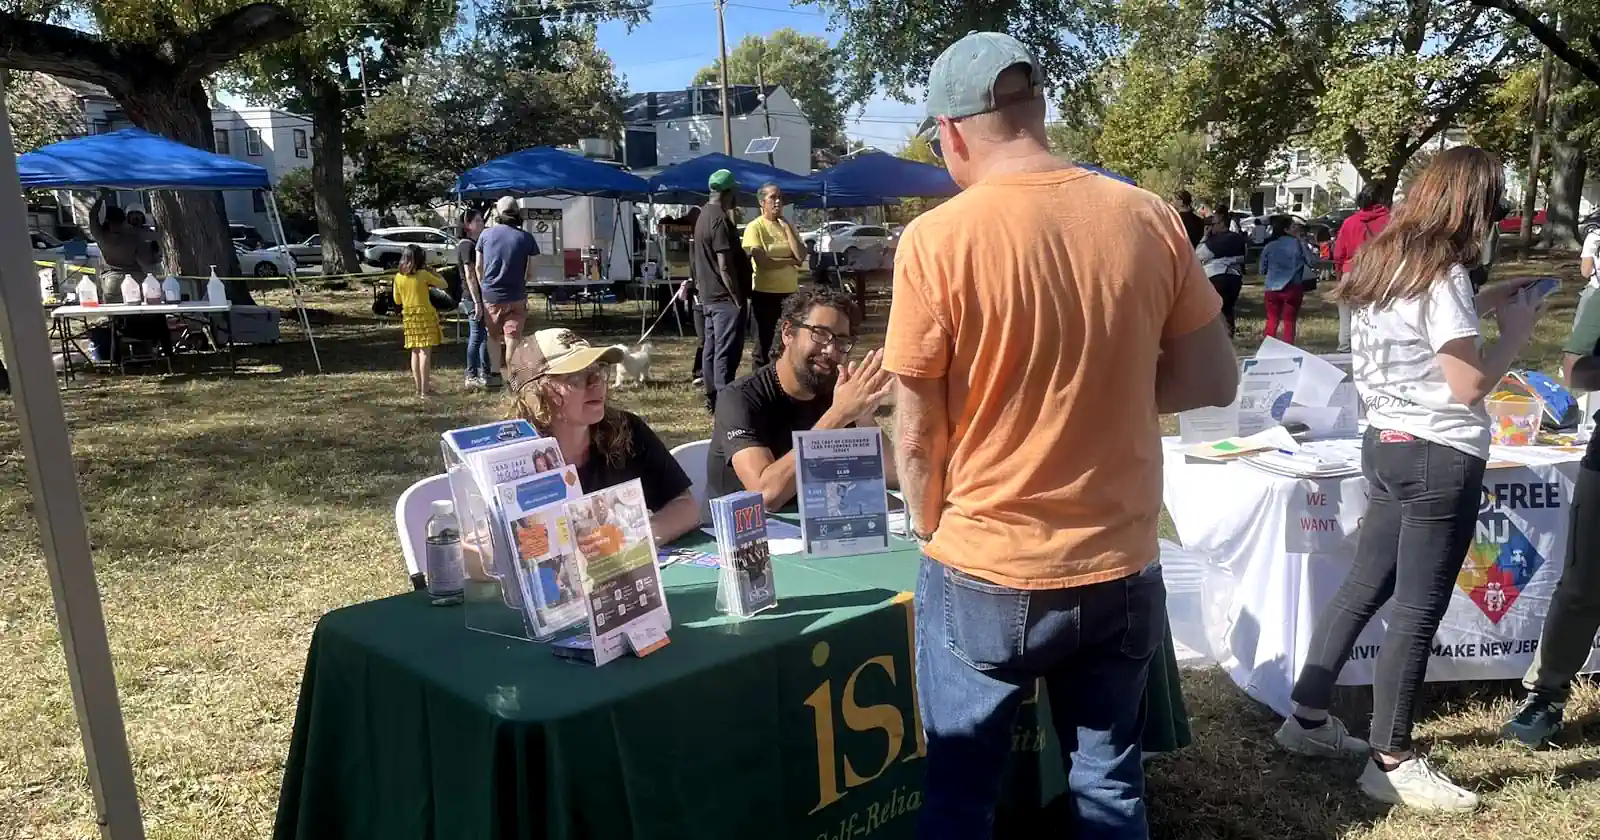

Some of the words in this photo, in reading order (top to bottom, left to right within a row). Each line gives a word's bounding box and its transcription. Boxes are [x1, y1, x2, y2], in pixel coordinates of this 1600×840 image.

[1306, 493, 1327, 506] WE
[1495, 482, 1561, 510] FREE
[1300, 517, 1337, 532] WANT
[1475, 519, 1510, 544] NJ
[1429, 643, 1476, 658] MAKE
[1480, 640, 1513, 657] NEW
[1515, 639, 1539, 654] JER
[803, 591, 928, 816] isl
